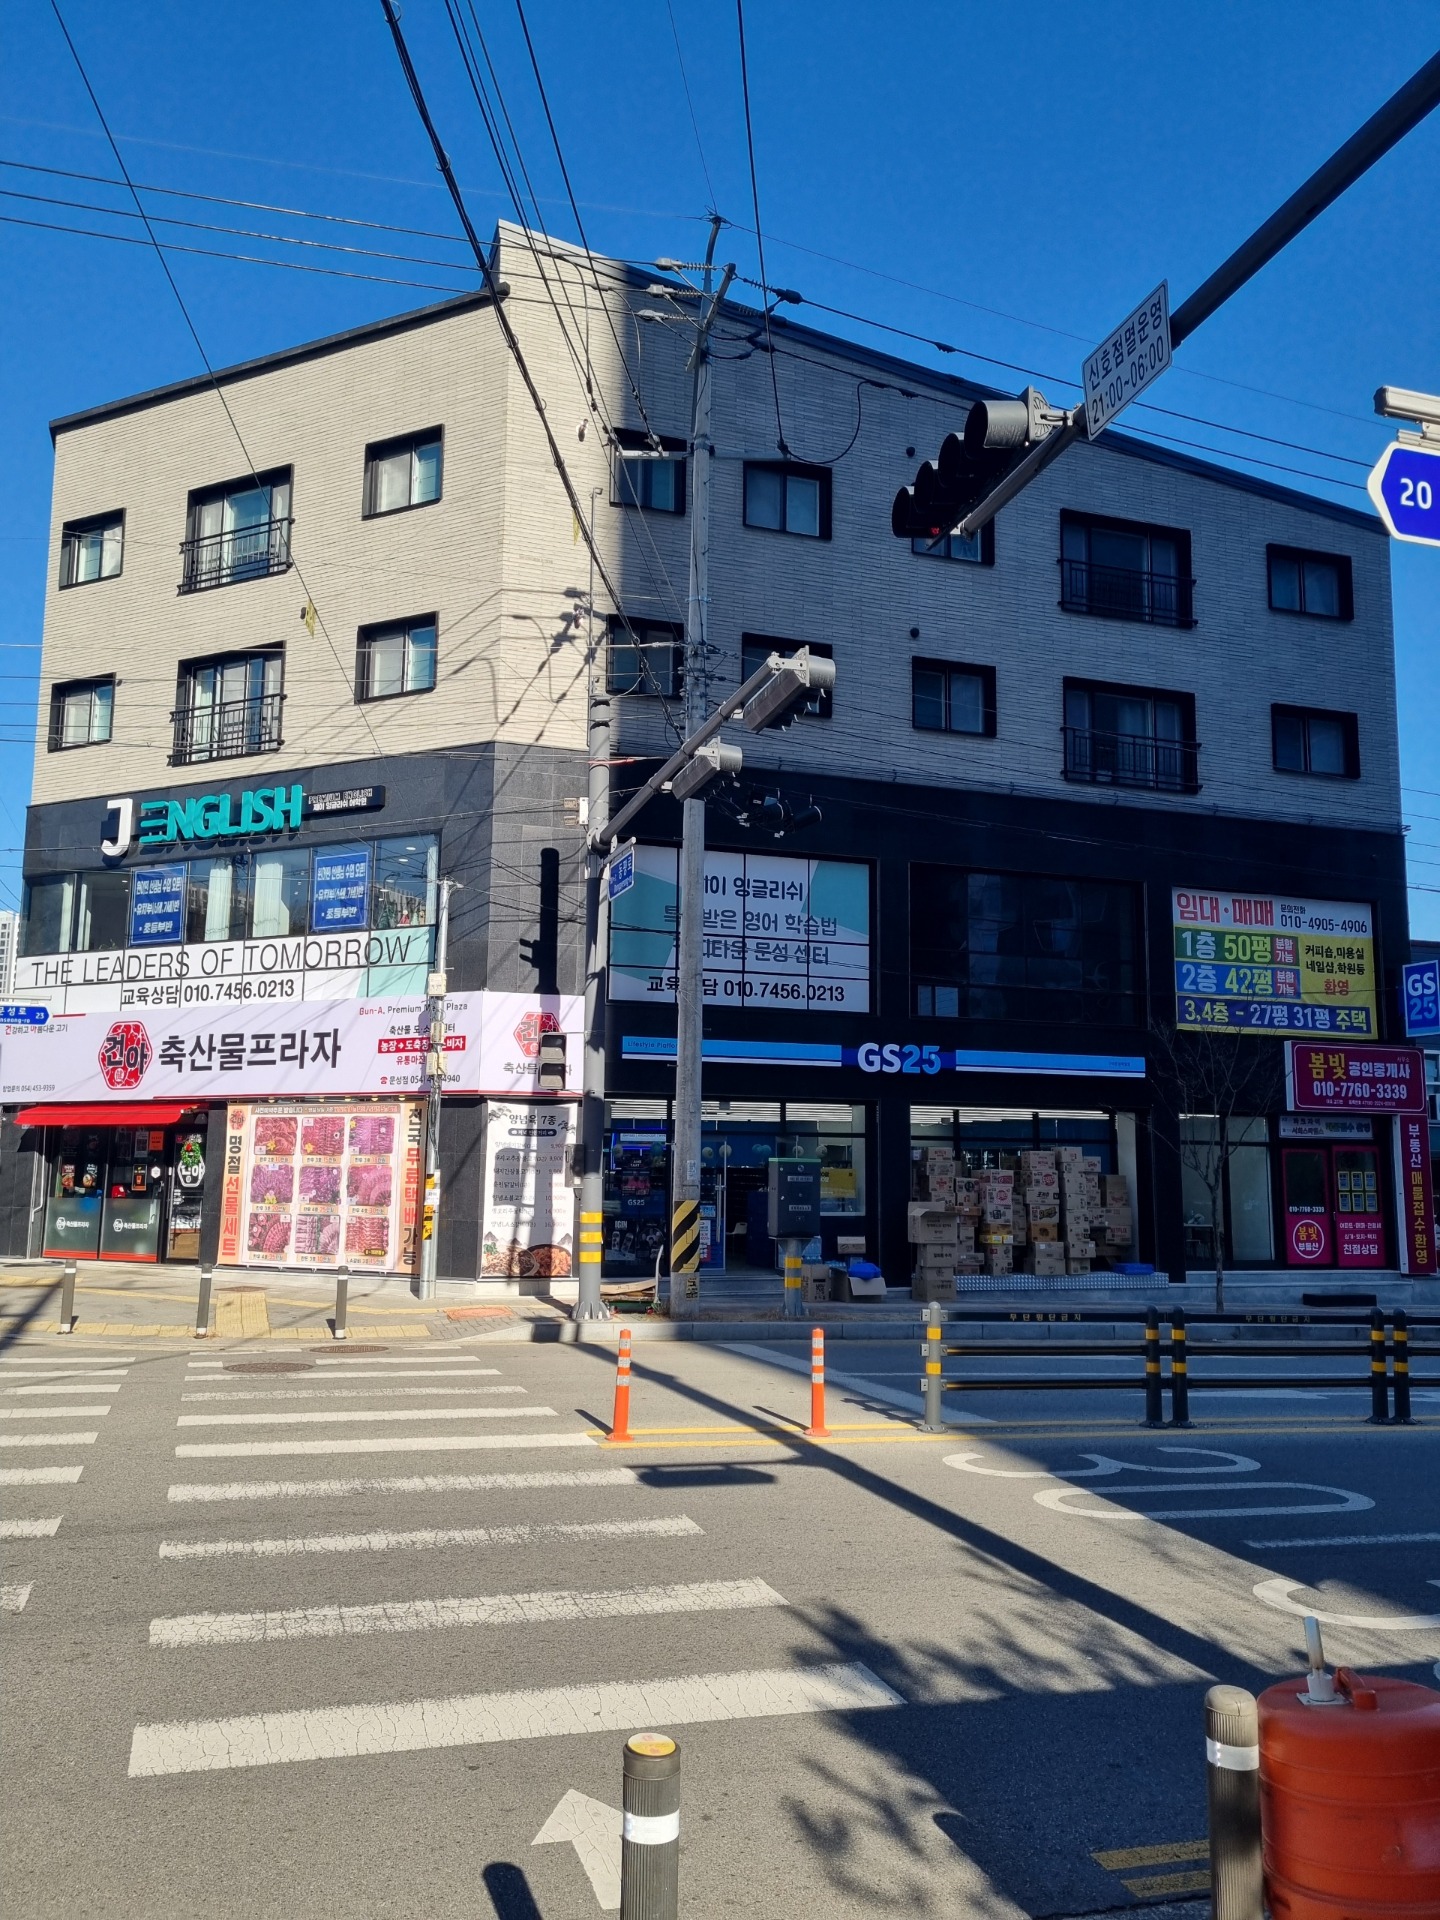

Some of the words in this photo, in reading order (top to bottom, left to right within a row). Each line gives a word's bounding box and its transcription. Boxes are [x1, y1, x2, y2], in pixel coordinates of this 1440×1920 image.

[1088, 295, 1162, 391] 신호점멸운영
[1091, 335, 1164, 425] 21:00~06:00
[1400, 478, 1432, 510] 20
[308, 793, 341, 805] PREMIUM
[343, 788, 373, 799] ENGLISH
[101, 798, 133, 856] J
[140, 785, 302, 844] ENGLISH
[734, 877, 803, 902] 잉글리쉬
[664, 904, 737, 932] 특받은
[744, 911, 778, 932] 영어
[785, 913, 837, 939] 학습법
[1280, 903, 1306, 915] 문의전화
[1280, 914, 1368, 934] 010-4905-4906
[754, 942, 789, 962] 문성
[794, 945, 829, 966] 센터
[1181, 931, 1216, 960] 1층
[1224, 934, 1272, 963] 50평
[1276, 951, 1294, 964] 가능
[1305, 944, 1365, 960] 커피숍,미용실
[31, 959, 74, 985] THE
[82, 952, 190, 983] LEADERS
[200, 948, 234, 975] OF
[244, 935, 411, 971] TOMORROW
[122, 985, 179, 1005] 교육상담
[184, 979, 295, 1003] 010.7456.0213
[646, 976, 718, 996] 교육담
[723, 979, 845, 1004] 010.7456.0213
[1181, 964, 1218, 993] 2층
[1224, 968, 1273, 996] 42평
[1277, 983, 1295, 997] 가능
[1324, 979, 1350, 997] 환영
[1408, 972, 1436, 996] GS
[36, 1012, 45, 1021] 23
[387, 1004, 422, 1014] Premium
[446, 1003, 468, 1011] Plaza
[1184, 1000, 1229, 1023] 3,4층
[1250, 1004, 1288, 1026] 27평
[1294, 1007, 1330, 1029] 31평
[1335, 1009, 1366, 1031] 주택
[1409, 996, 1437, 1020] 25
[56, 1024, 68, 1033] 고기
[389, 1025, 411, 1035] 축산물
[104, 1033, 148, 1075] 건아
[158, 1028, 342, 1073] 축산물프라자
[380, 1041, 396, 1052] 농장
[405, 1040, 429, 1051] 도축장
[627, 1041, 656, 1049] Lifestyle
[858, 1043, 942, 1075] GS25
[1308, 1052, 1347, 1080] 봄빛
[1348, 1061, 1411, 1079] 공인중개사
[1313, 1081, 1408, 1100] 010-7760-3339
[408, 1108, 422, 1146] 전국
[540, 1115, 557, 1126] 7종
[228, 1136, 243, 1175] 명절
[1409, 1124, 1422, 1168] 부동산
[404, 1147, 421, 1225] 무료택배
[221, 1176, 240, 1256] 선물세트
[1298, 1226, 1318, 1241] 봄빛
[403, 1227, 419, 1266] 가능
[1343, 1244, 1379, 1255] 친절상담
